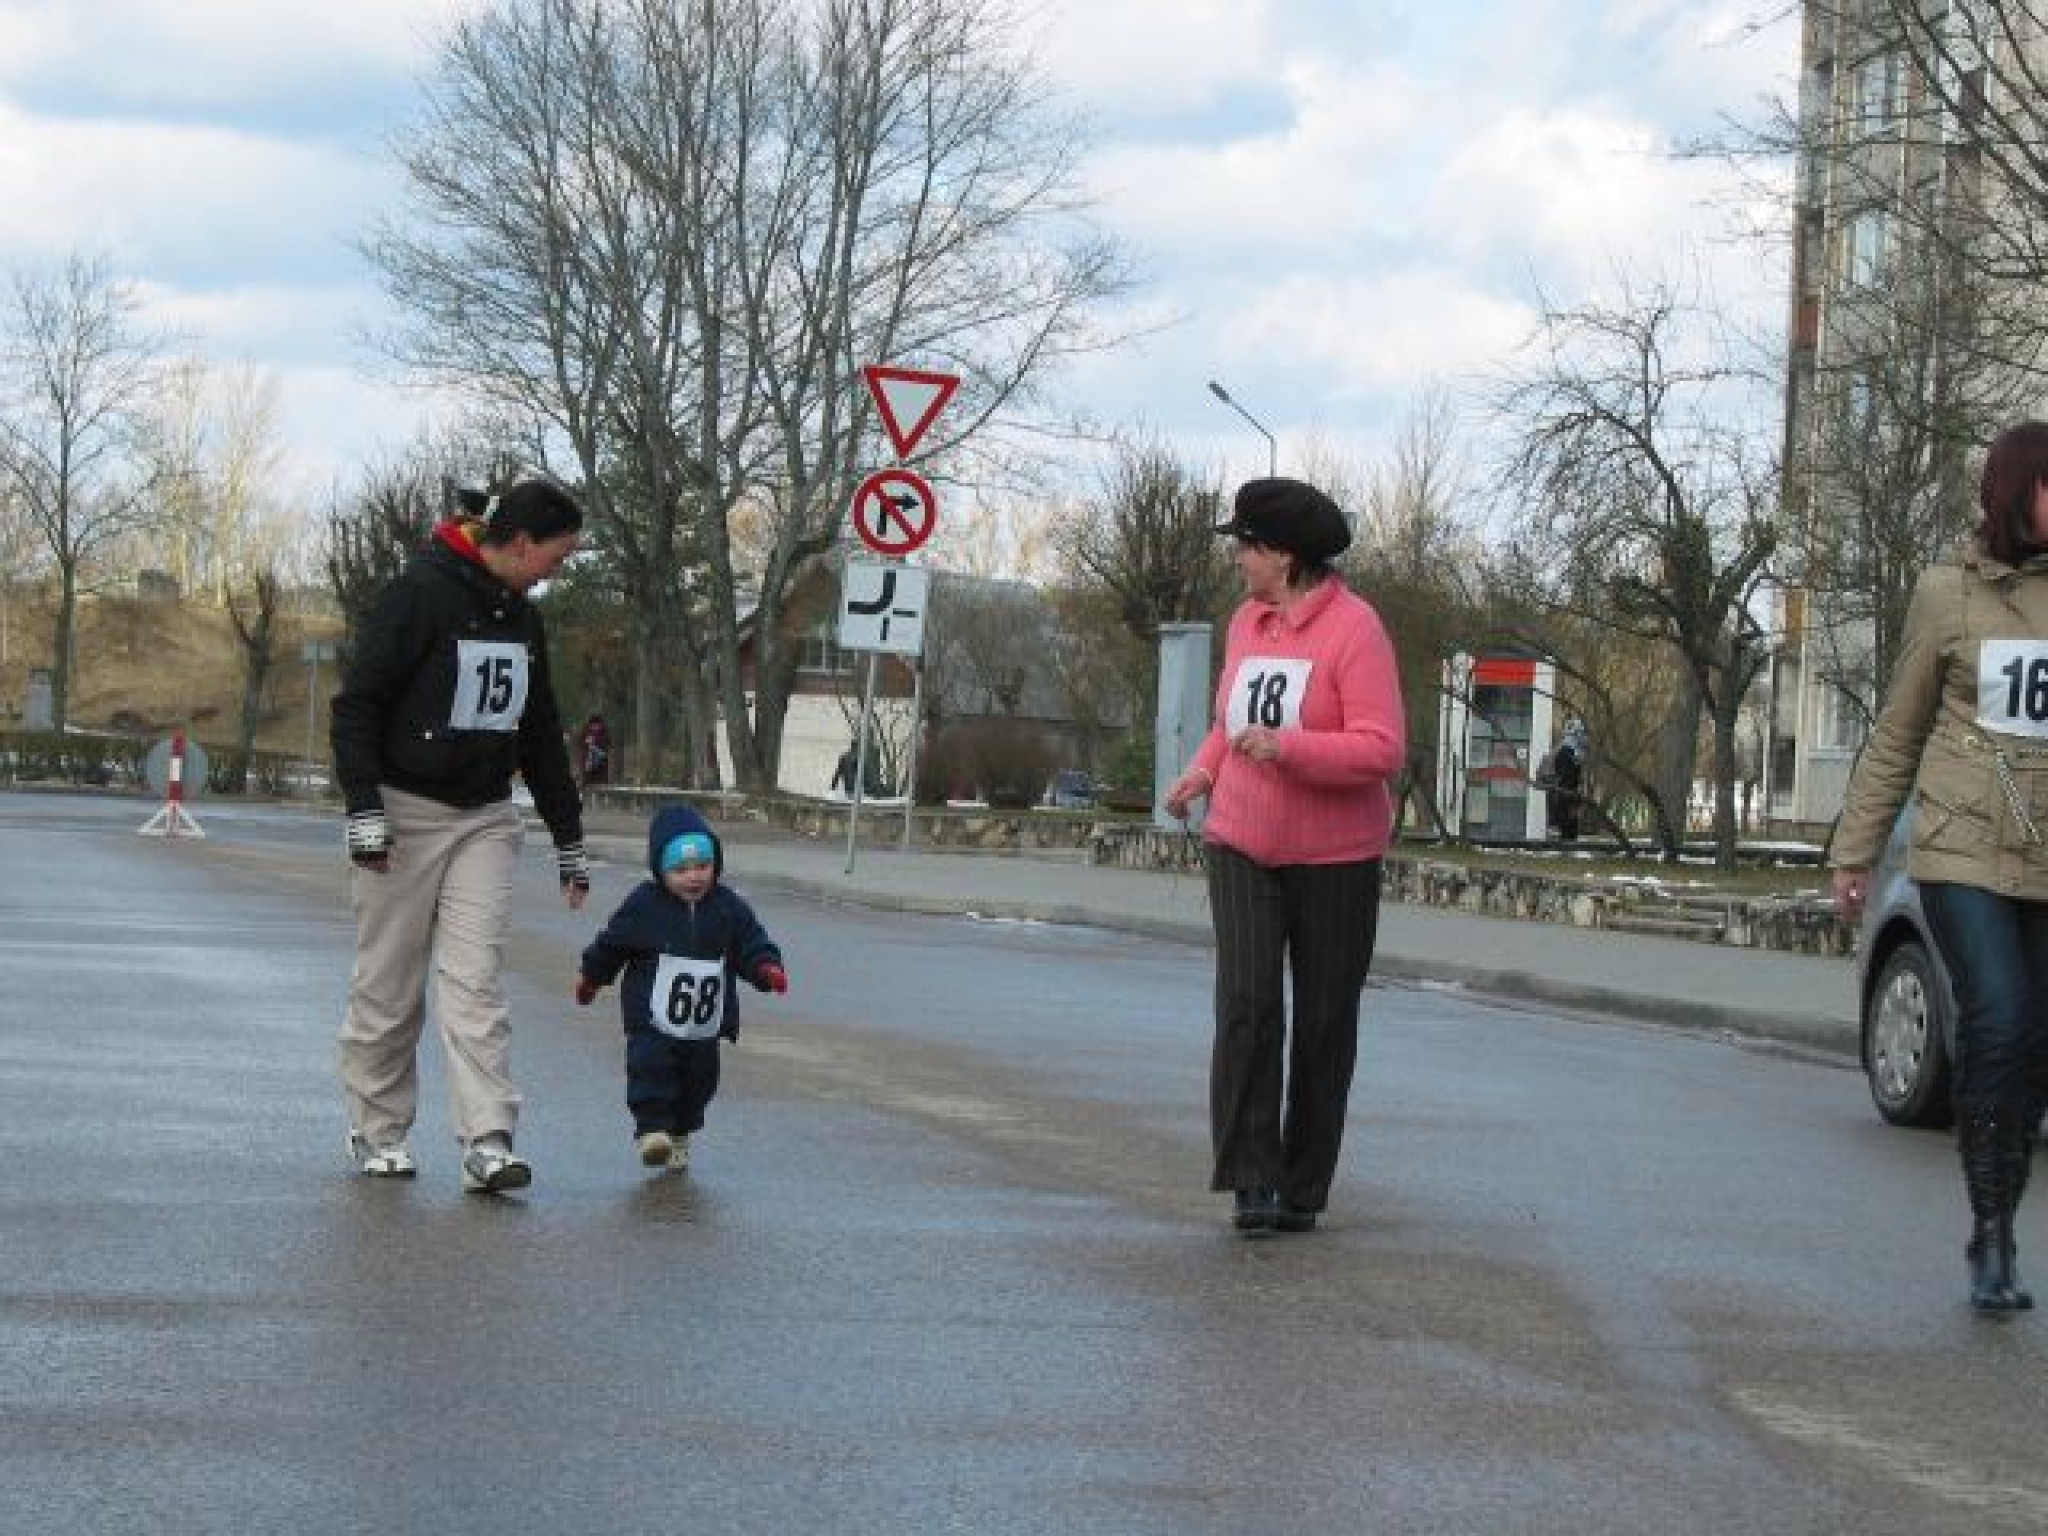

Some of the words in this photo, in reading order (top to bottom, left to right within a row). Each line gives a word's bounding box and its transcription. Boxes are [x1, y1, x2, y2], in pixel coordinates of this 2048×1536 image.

[477, 656, 512, 714] 15
[1247, 672, 1287, 728] 18
[2002, 656, 2048, 722] 16
[668, 973, 720, 1026] 68
